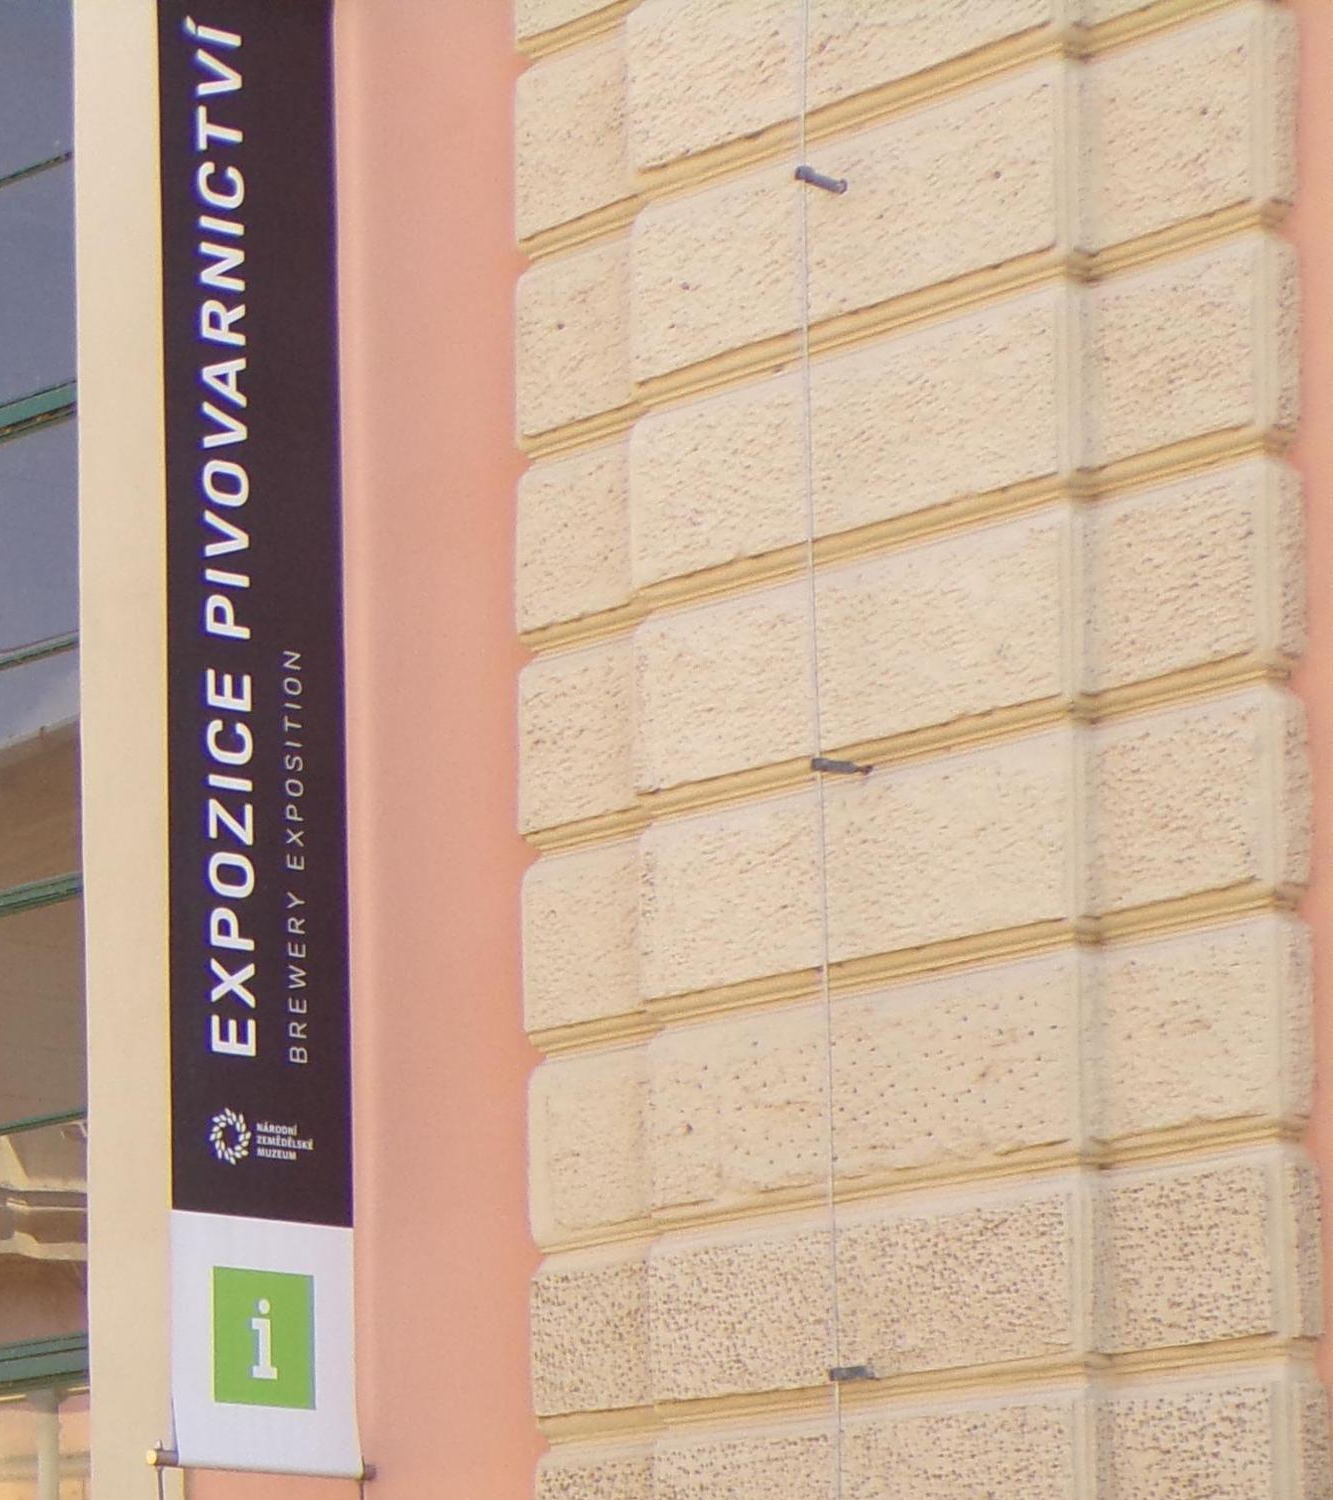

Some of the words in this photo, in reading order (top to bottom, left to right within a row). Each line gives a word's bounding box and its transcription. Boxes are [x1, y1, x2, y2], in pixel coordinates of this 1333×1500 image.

[183, 14, 252, 642] PIVOVARNICTVÍ
[281, 648, 306, 872] EXPOSITION
[205, 667, 258, 1058] EXPOZICE
[284, 893, 309, 1065] BREWERY
[256, 1121, 298, 1136] NÁRODNÍ
[256, 1134, 314, 1151] ZEMĚDĚLSKÉ
[257, 1147, 297, 1161] MUZEUM
